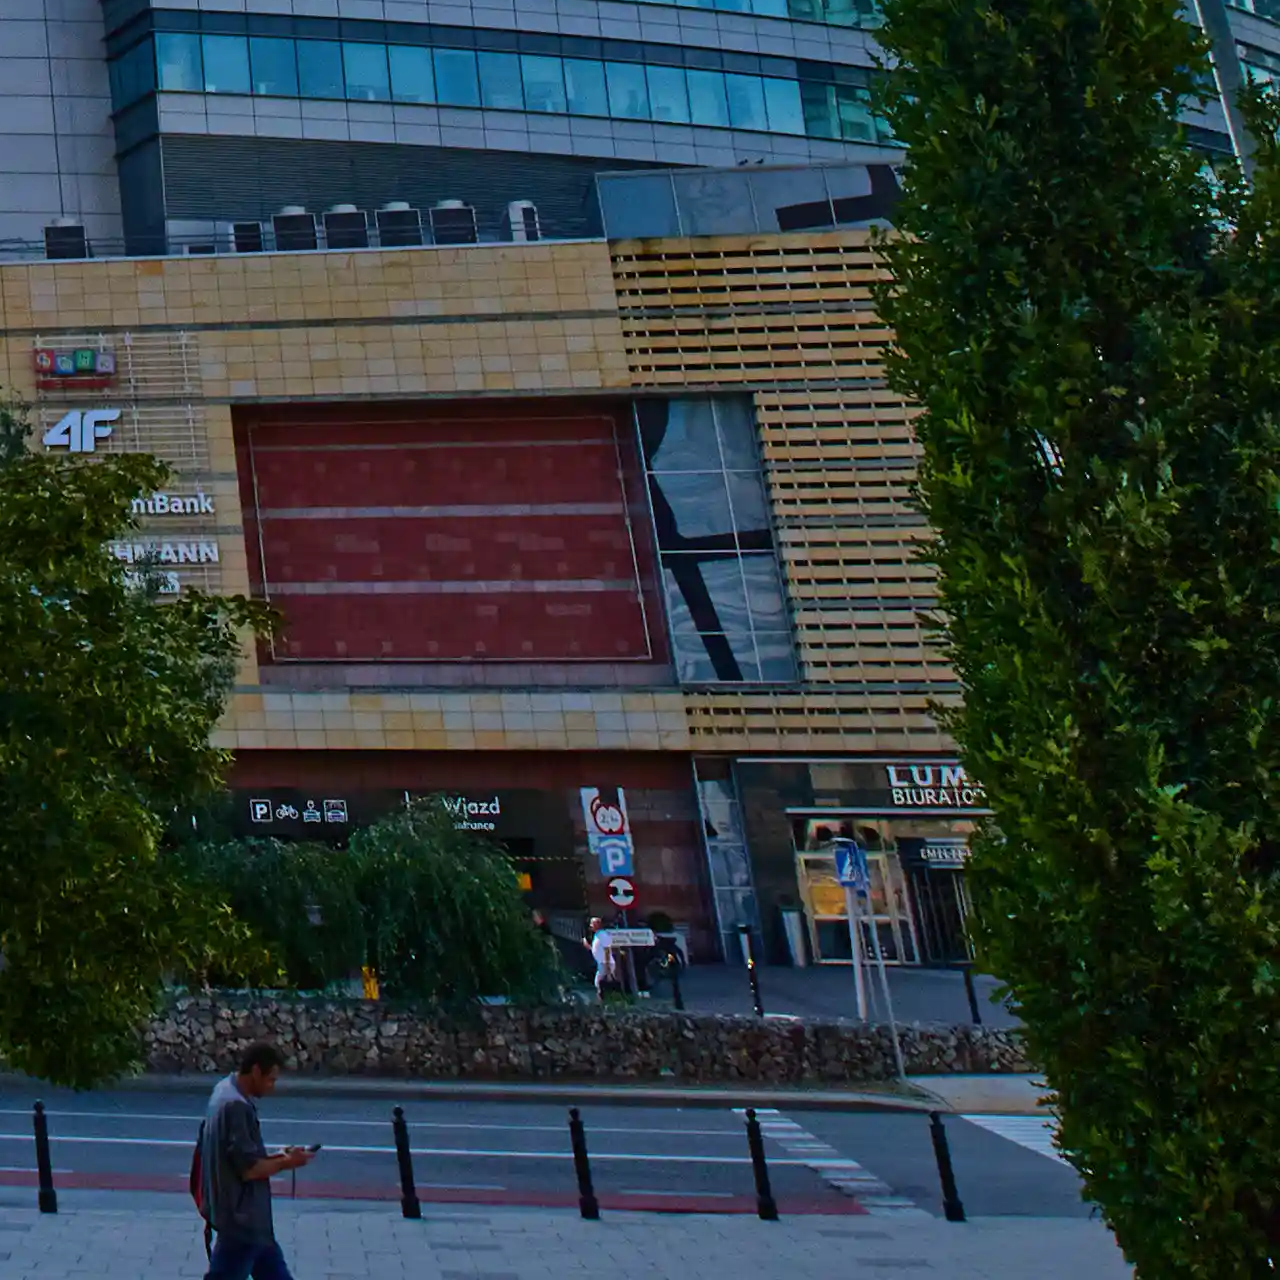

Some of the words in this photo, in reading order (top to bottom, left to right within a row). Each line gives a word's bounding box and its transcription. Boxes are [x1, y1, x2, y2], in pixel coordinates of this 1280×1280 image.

[42, 409, 122, 453] 4F
[442, 795, 501, 821] Wjazd
[892, 788, 952, 806] BIURA
